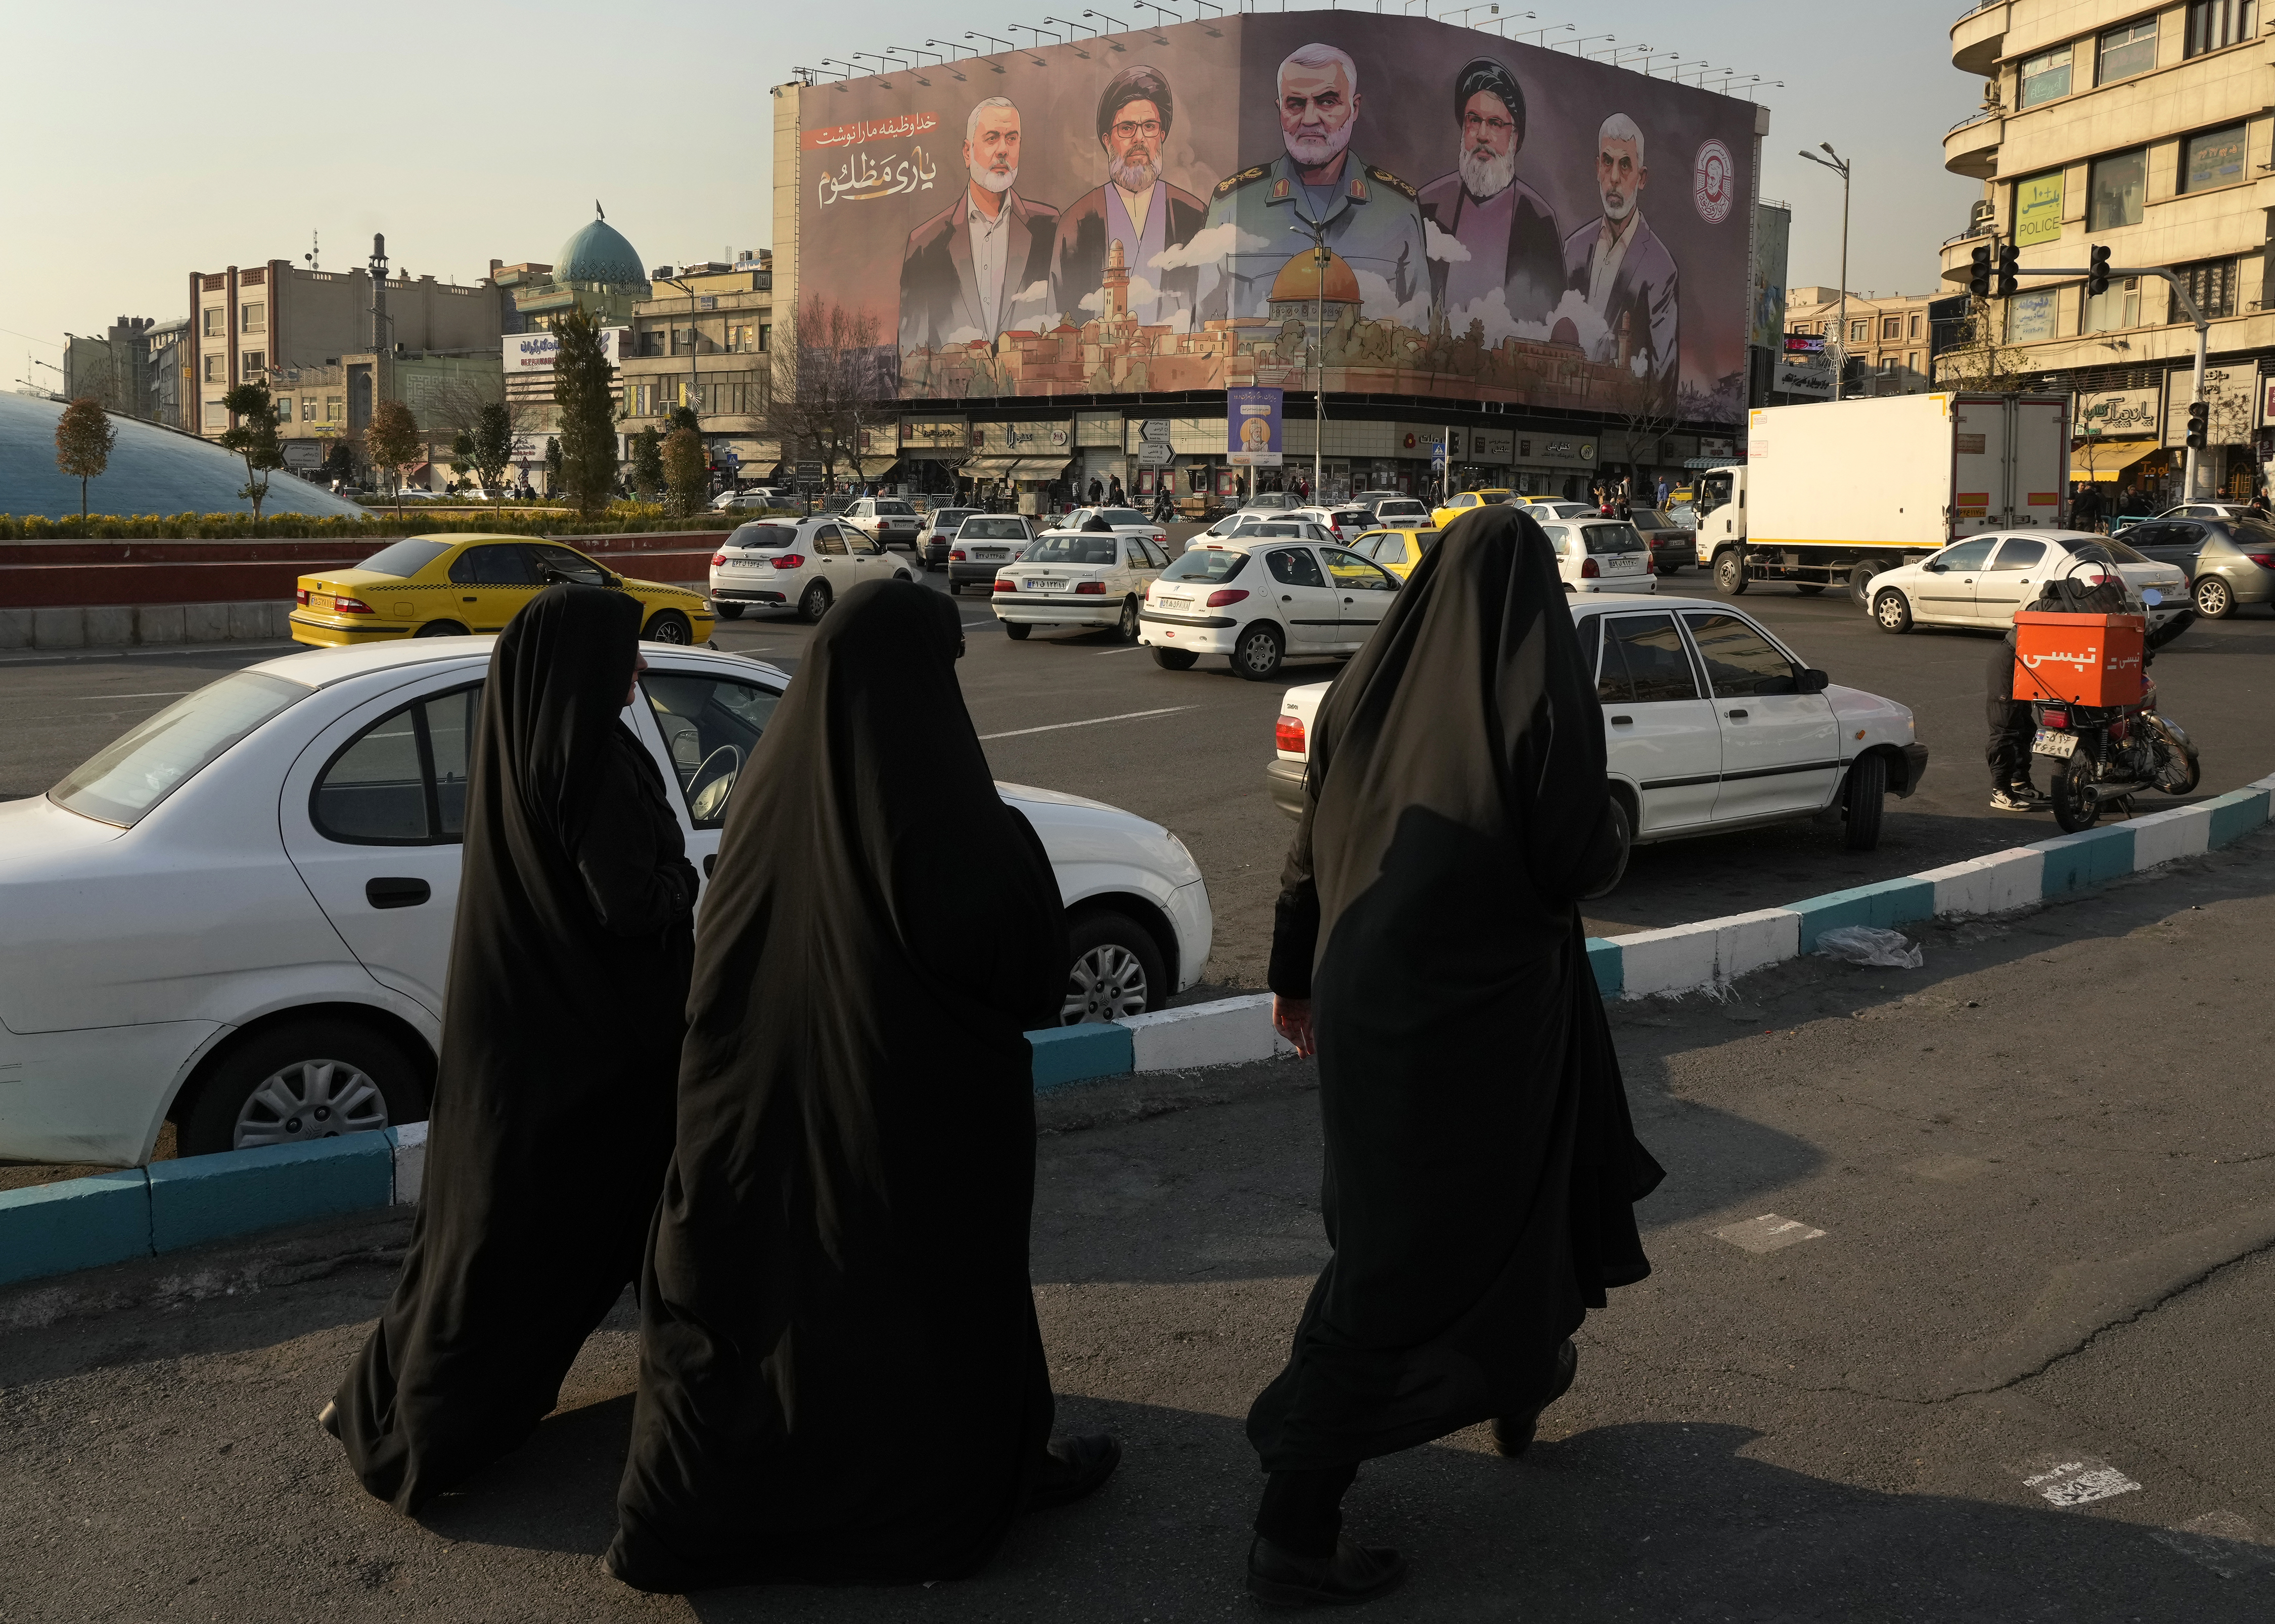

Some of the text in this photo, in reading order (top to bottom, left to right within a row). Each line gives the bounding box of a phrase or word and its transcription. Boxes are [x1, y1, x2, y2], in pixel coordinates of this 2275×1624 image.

[816, 112, 936, 147] خدا وظیفه ما را نوشت
[2022, 190, 2060, 214] پلیس
[2020, 216, 2060, 237] POLICE
[521, 338, 548, 354] کارگران
[1016, 433, 1032, 442] کفش
[1547, 442, 1570, 451] کفش ملی
[2024, 647, 2096, 672] تپسی
[2119, 652, 2140, 669] تپسی
